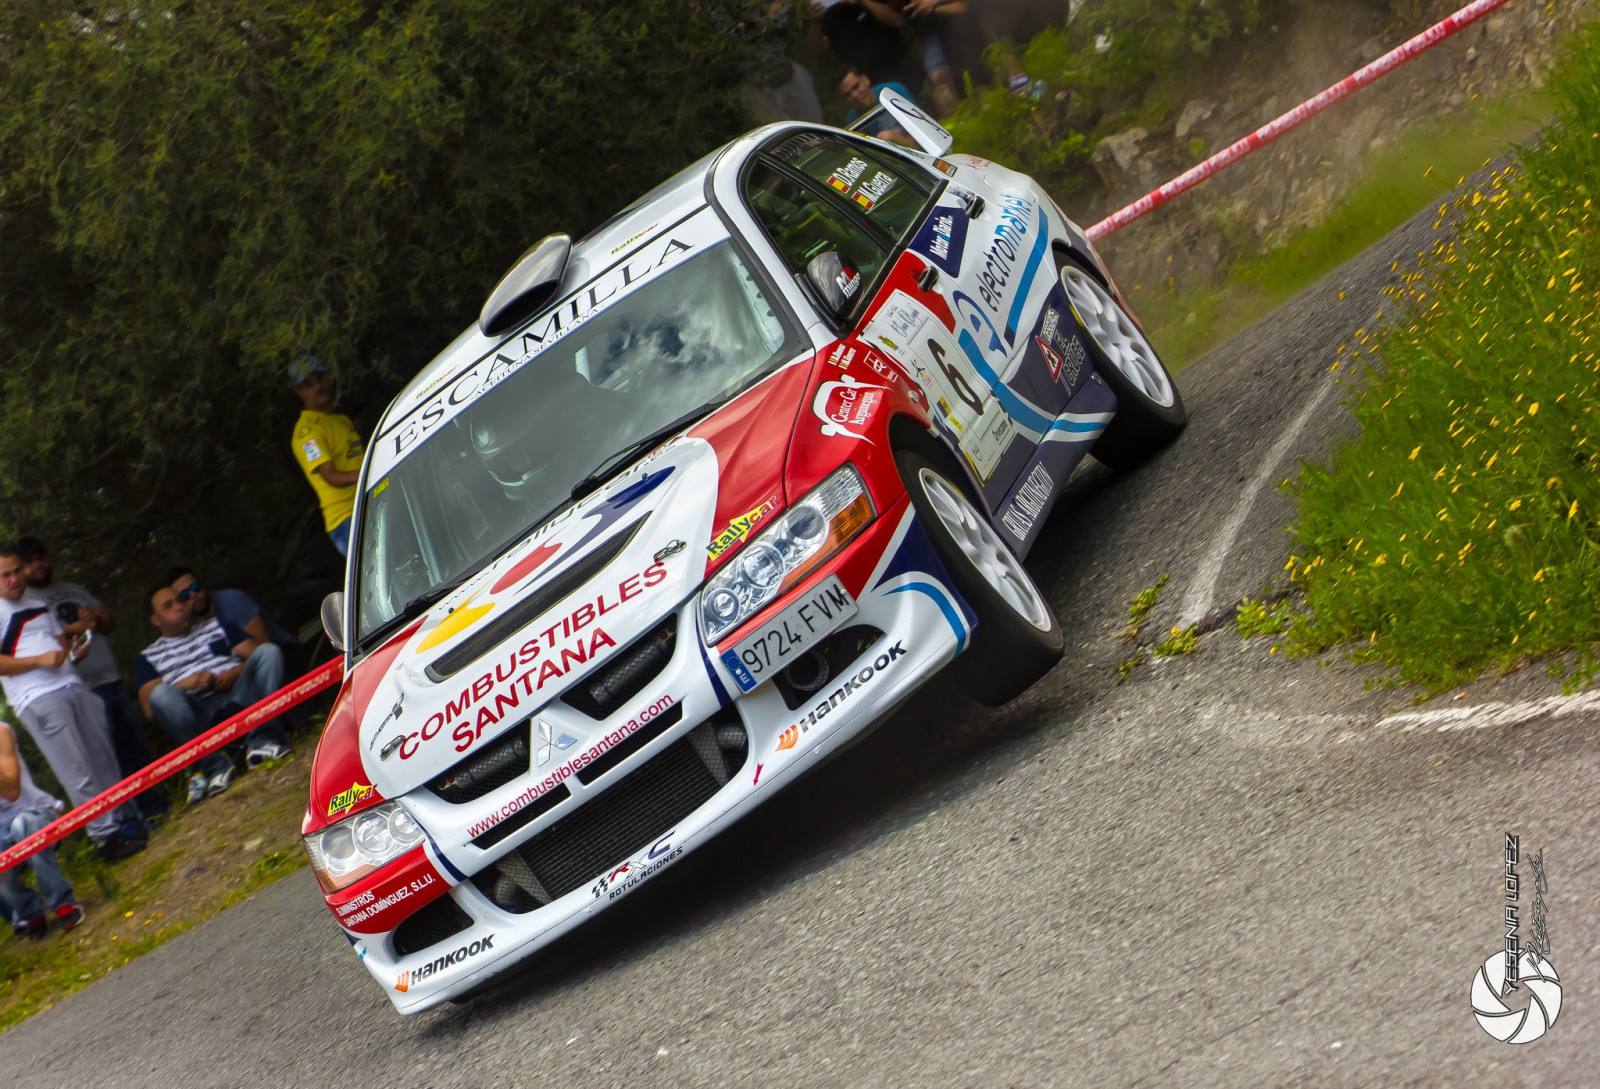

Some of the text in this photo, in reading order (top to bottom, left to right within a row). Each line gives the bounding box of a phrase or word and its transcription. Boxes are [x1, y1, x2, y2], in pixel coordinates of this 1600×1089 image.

[833, 157, 868, 185] D.Ramos
[860, 170, 892, 203] M.Guerra
[978, 194, 1033, 313] electromarket
[392, 238, 696, 459] ESCAMILLA
[927, 338, 985, 416] 6
[832, 387, 857, 424] Center Car
[706, 495, 777, 556] Rallycar
[741, 582, 850, 675] 9724 FVM
[399, 561, 668, 761] COMBUSTIBLES
[740, 672, 750, 684] E
[452, 627, 617, 754] SANTANA
[467, 693, 674, 840] www.combustiblesantana.com
[329, 783, 378, 813] Rallycar
[344, 872, 437, 928] SANTANA DOMÍNGUEZ, S.L.U.
[608, 845, 684, 901] ROTULACIONES
[337, 890, 375, 918] SUMINISTROS
